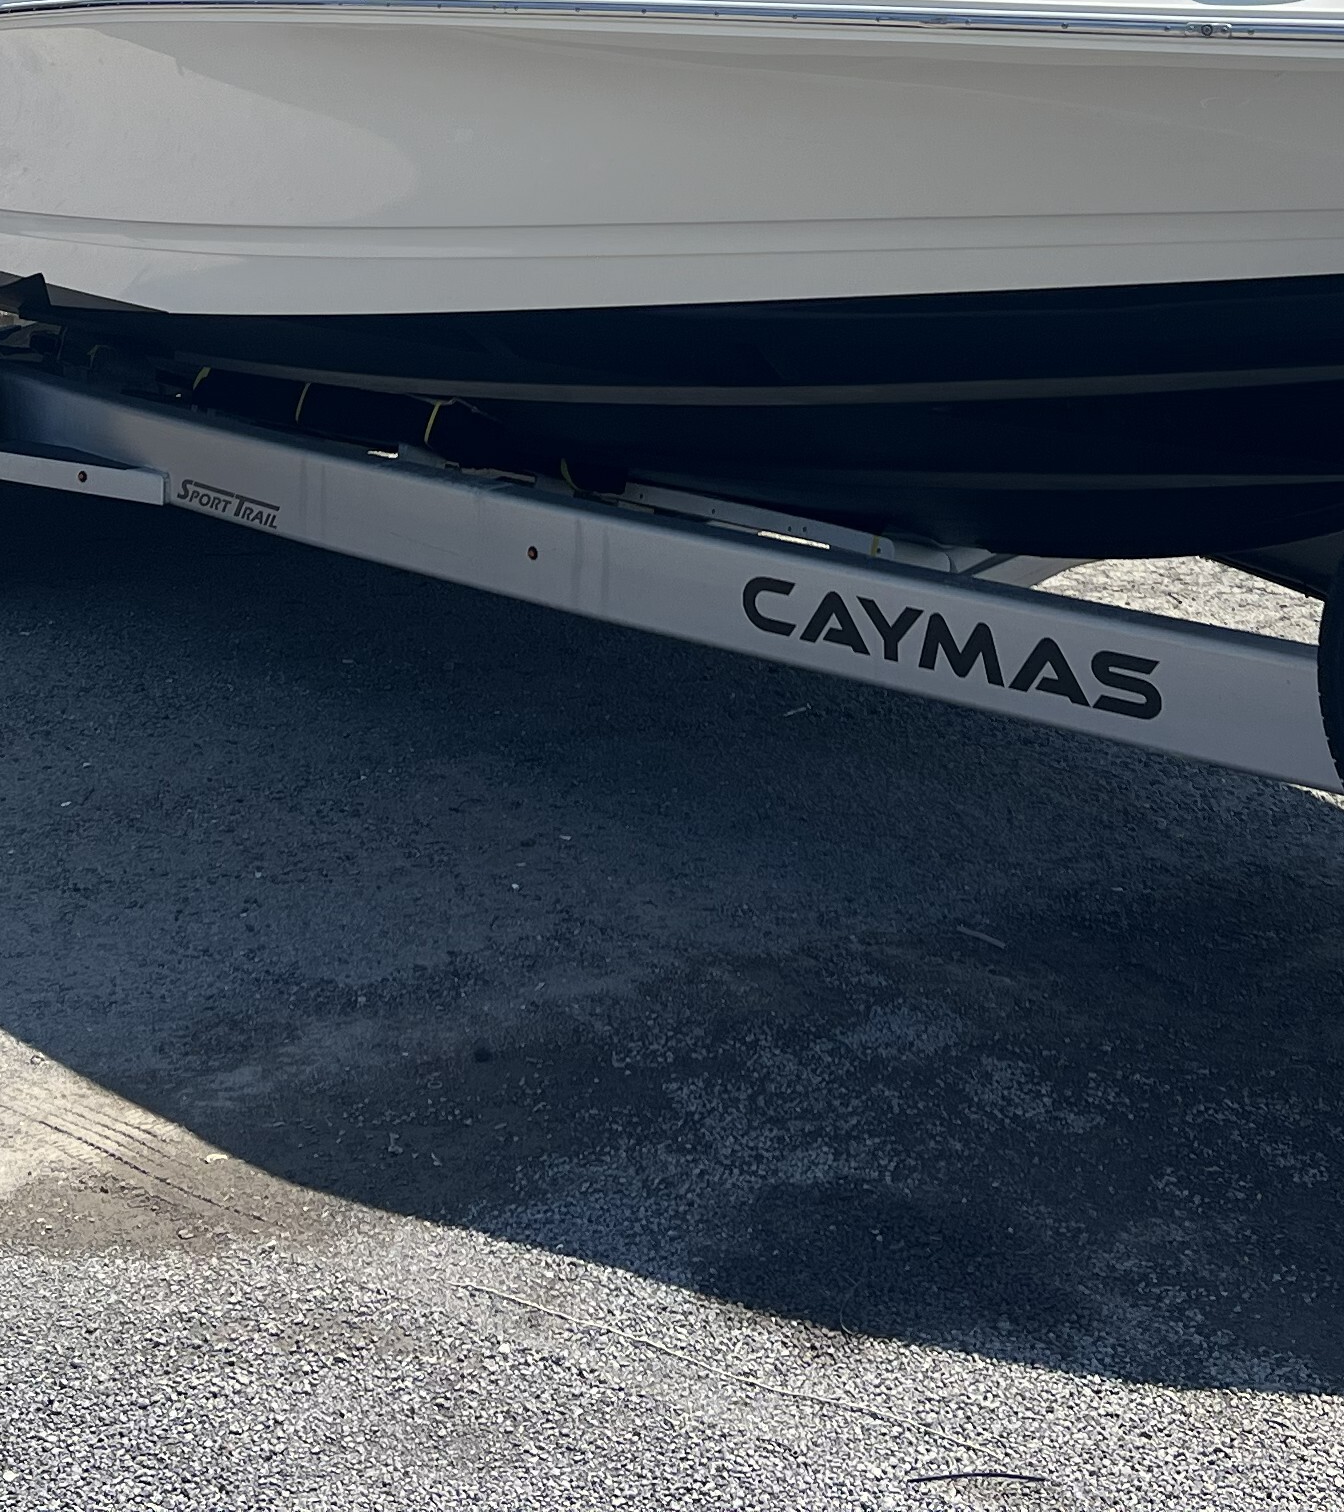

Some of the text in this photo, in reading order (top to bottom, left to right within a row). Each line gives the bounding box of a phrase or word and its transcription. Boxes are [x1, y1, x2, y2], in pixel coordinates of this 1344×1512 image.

[176, 478, 281, 530] SPORT TRAIL
[741, 576, 1163, 720] CAYMAS
